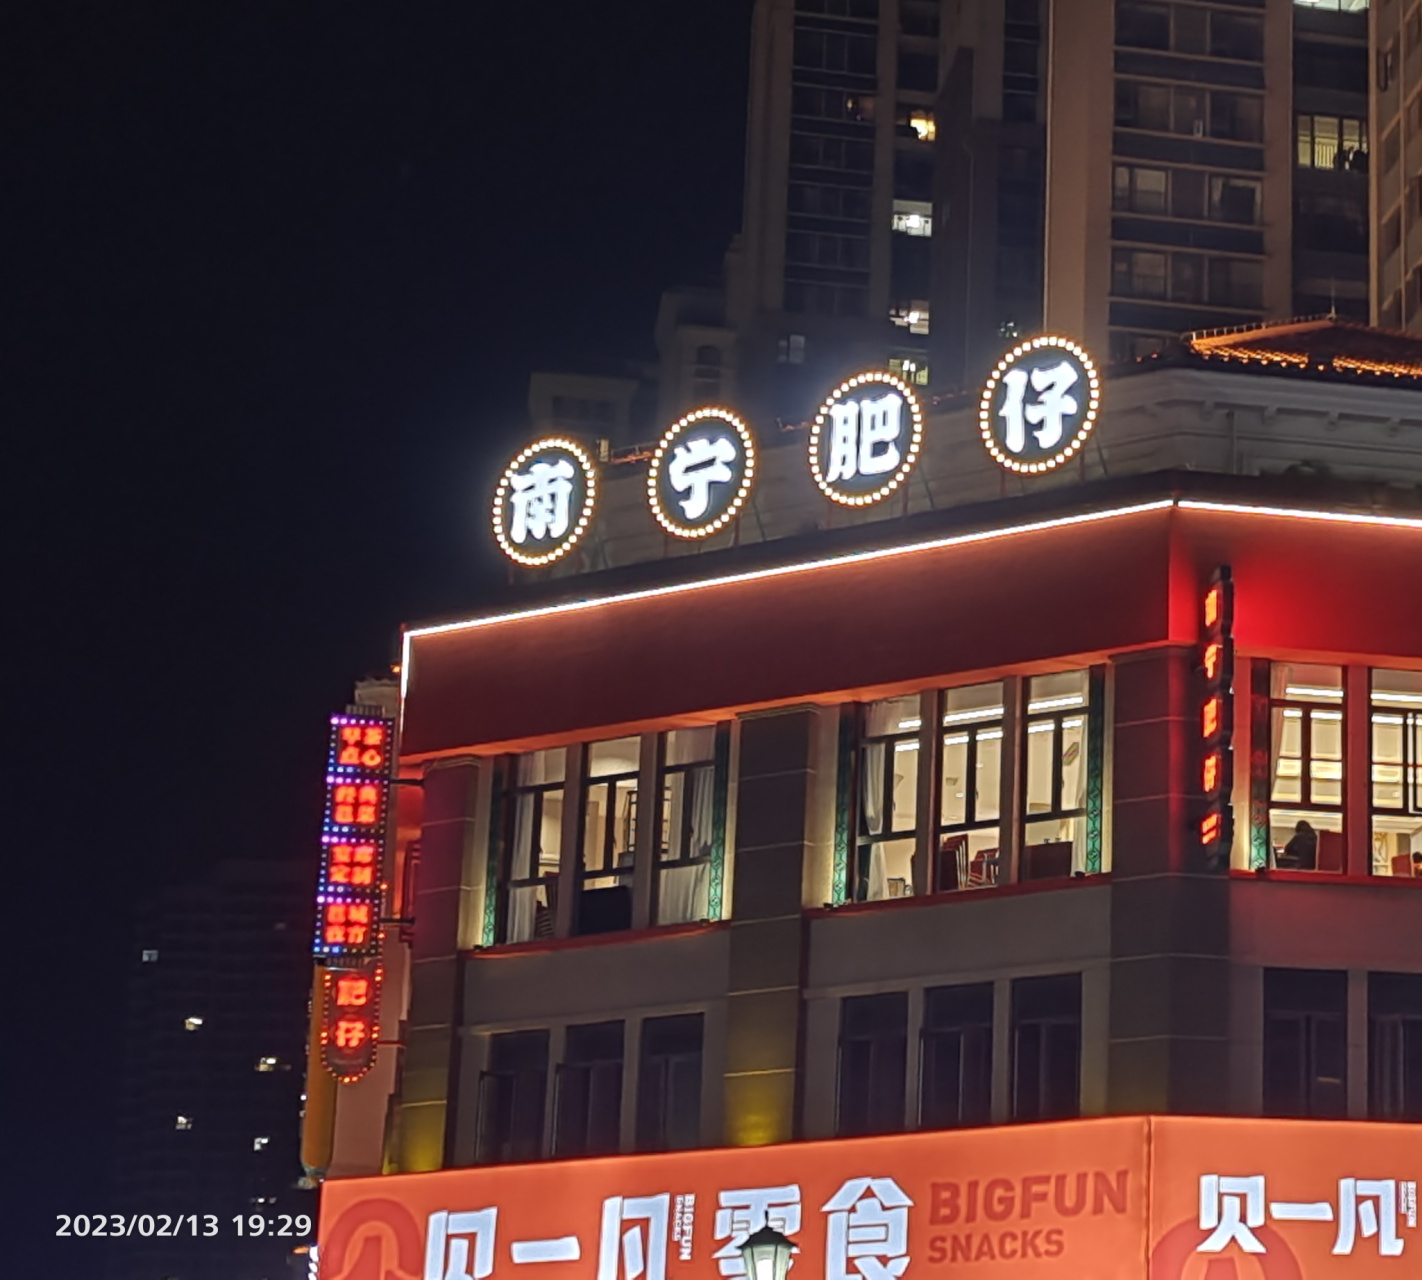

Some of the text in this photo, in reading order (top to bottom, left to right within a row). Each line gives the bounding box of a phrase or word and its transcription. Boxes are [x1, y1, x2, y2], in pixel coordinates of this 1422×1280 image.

[510, 361, 1078, 543] 南宁肥仔
[928, 1169, 1130, 1224] BIGFUN
[927, 1227, 1066, 1264] SNACKS
